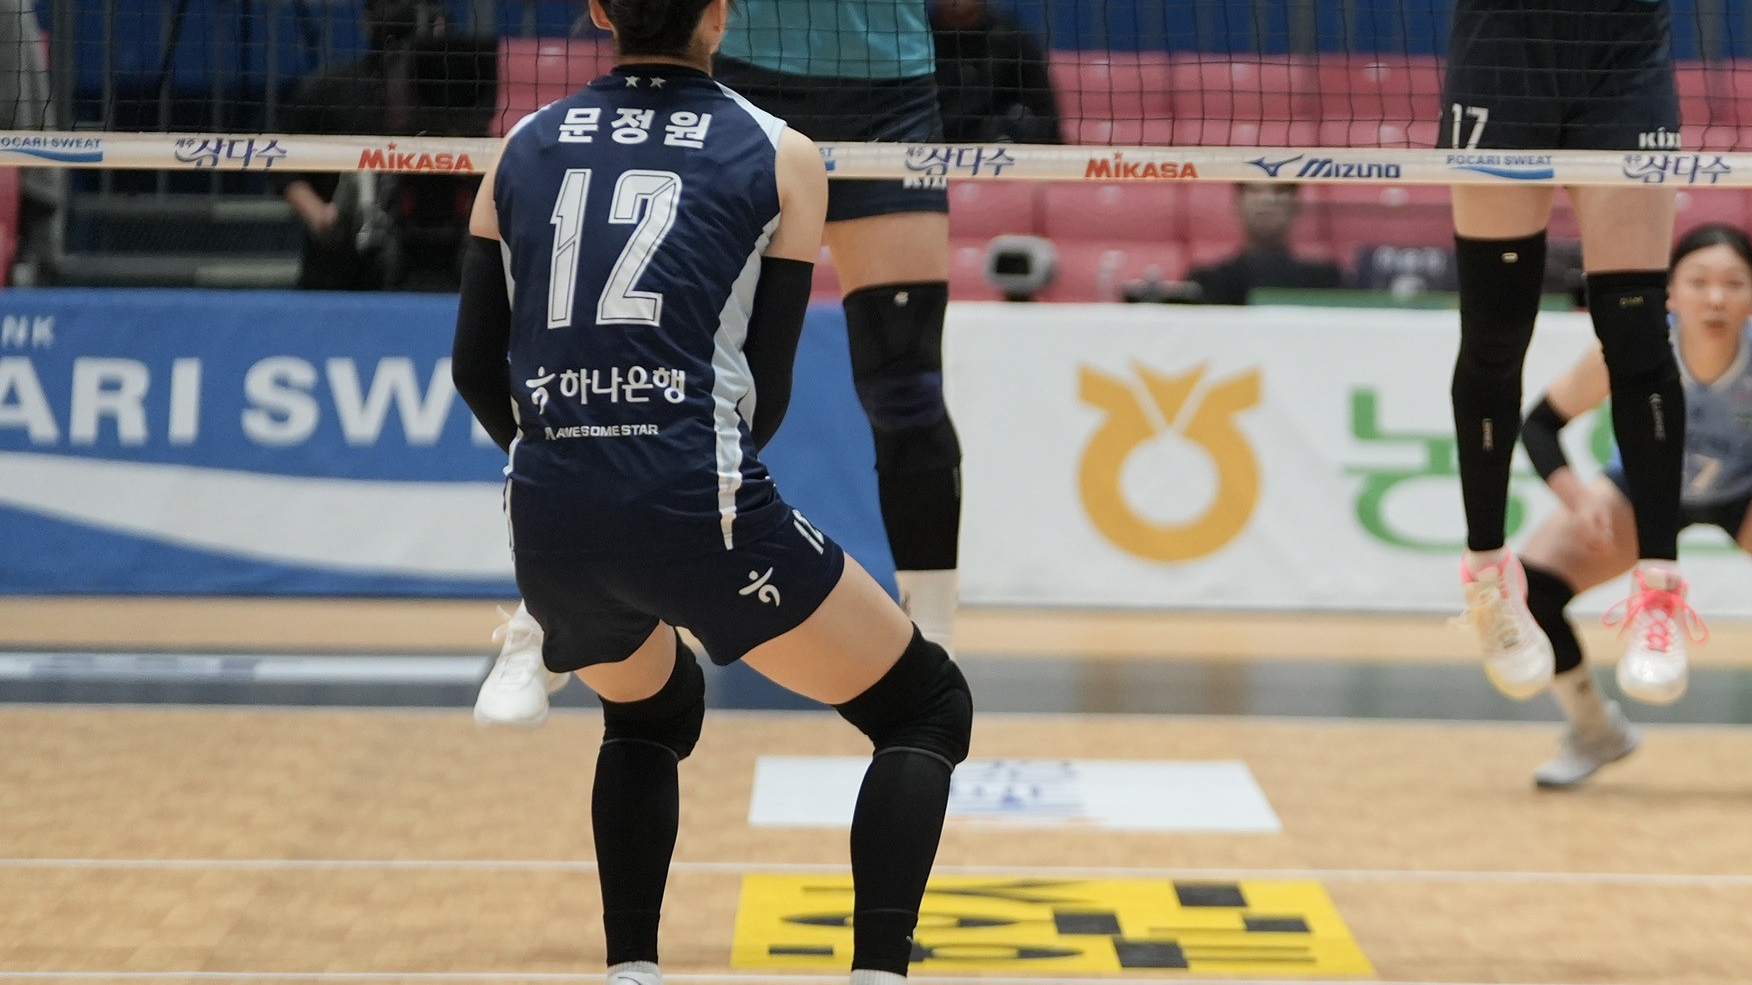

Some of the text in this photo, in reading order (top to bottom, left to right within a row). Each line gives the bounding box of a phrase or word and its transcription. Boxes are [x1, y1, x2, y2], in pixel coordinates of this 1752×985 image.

[558, 106, 713, 150] 문정원
[1451, 102, 1489, 149] 17
[547, 167, 684, 330] 12
[241, 355, 500, 448] SW
[559, 365, 687, 406] 하나은행
